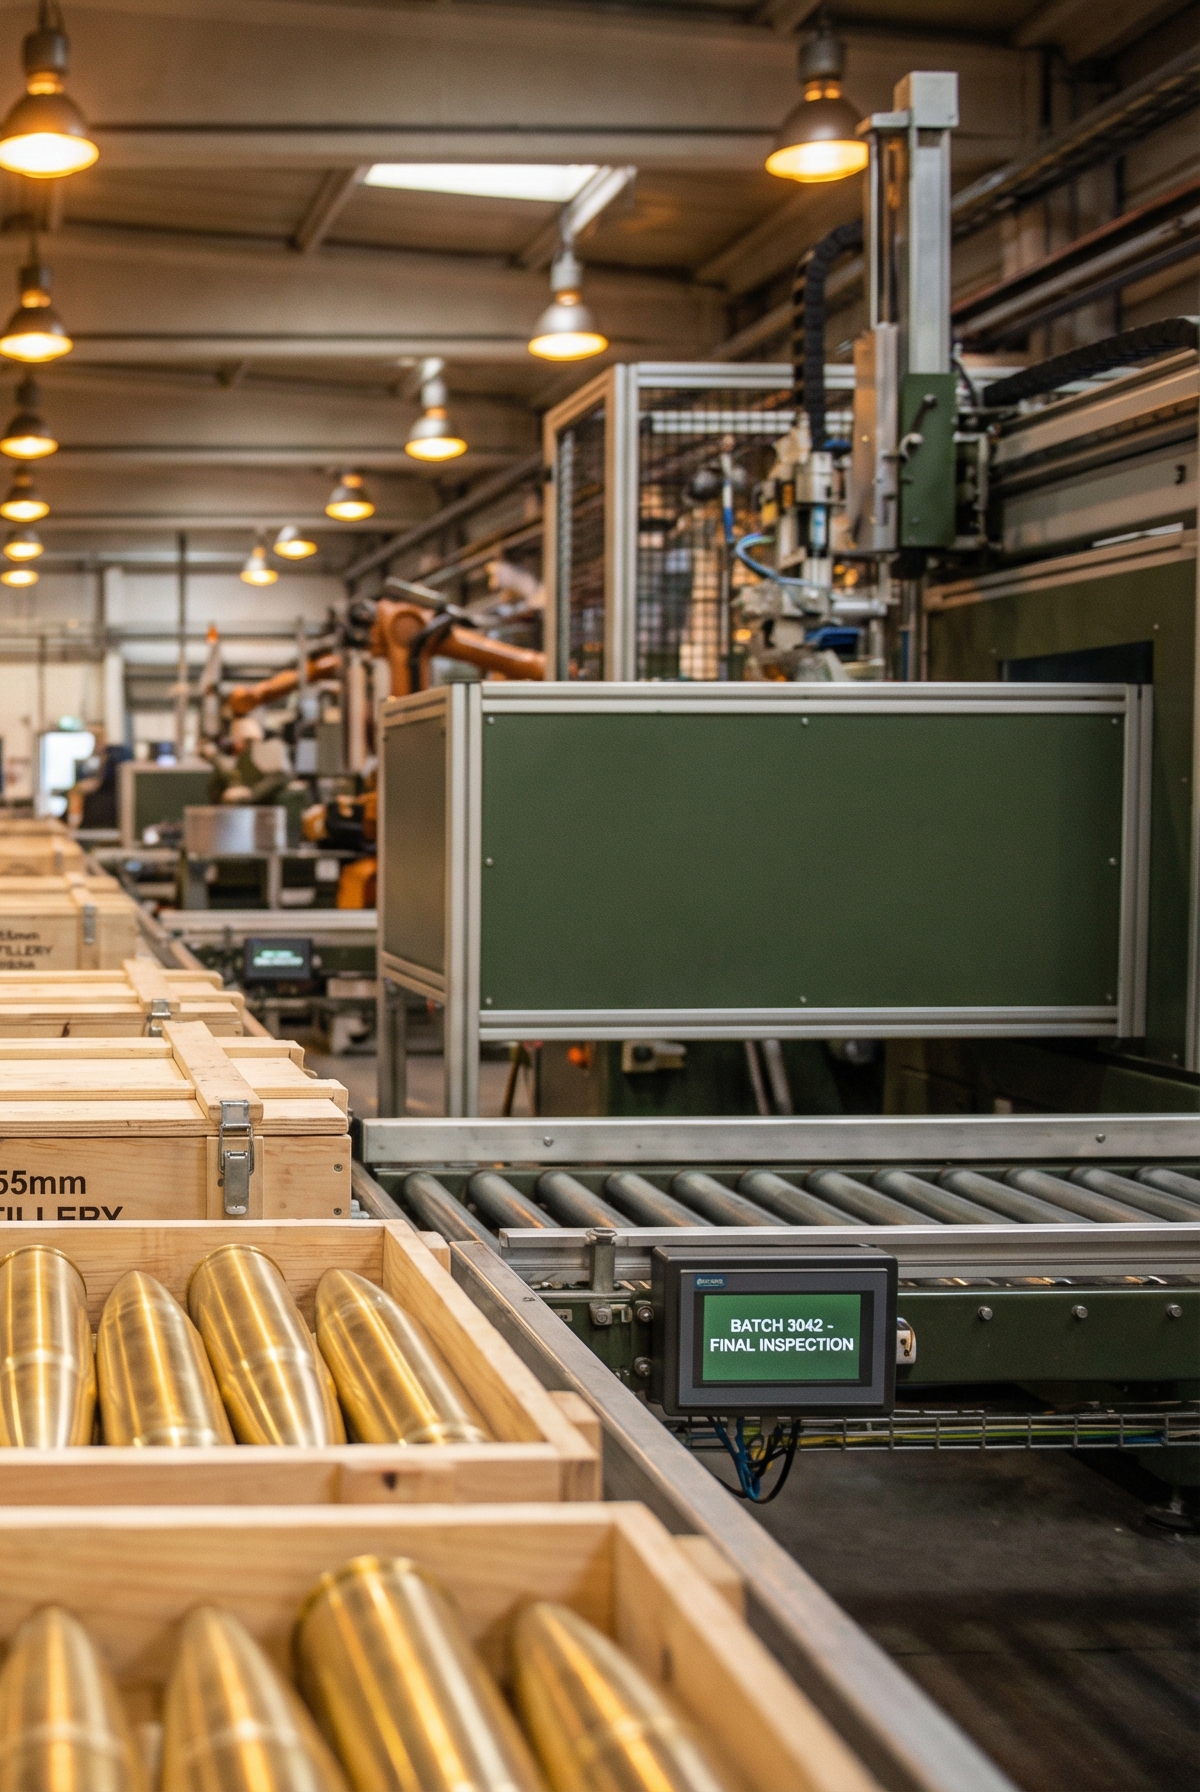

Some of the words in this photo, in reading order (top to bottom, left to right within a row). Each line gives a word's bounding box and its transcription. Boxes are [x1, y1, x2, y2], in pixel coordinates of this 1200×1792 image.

[730, 1318, 784, 1333] BATCH
[787, 1318, 824, 1333] 3042
[710, 1338, 756, 1352] FINAL
[759, 1337, 854, 1351] INSPECTION
